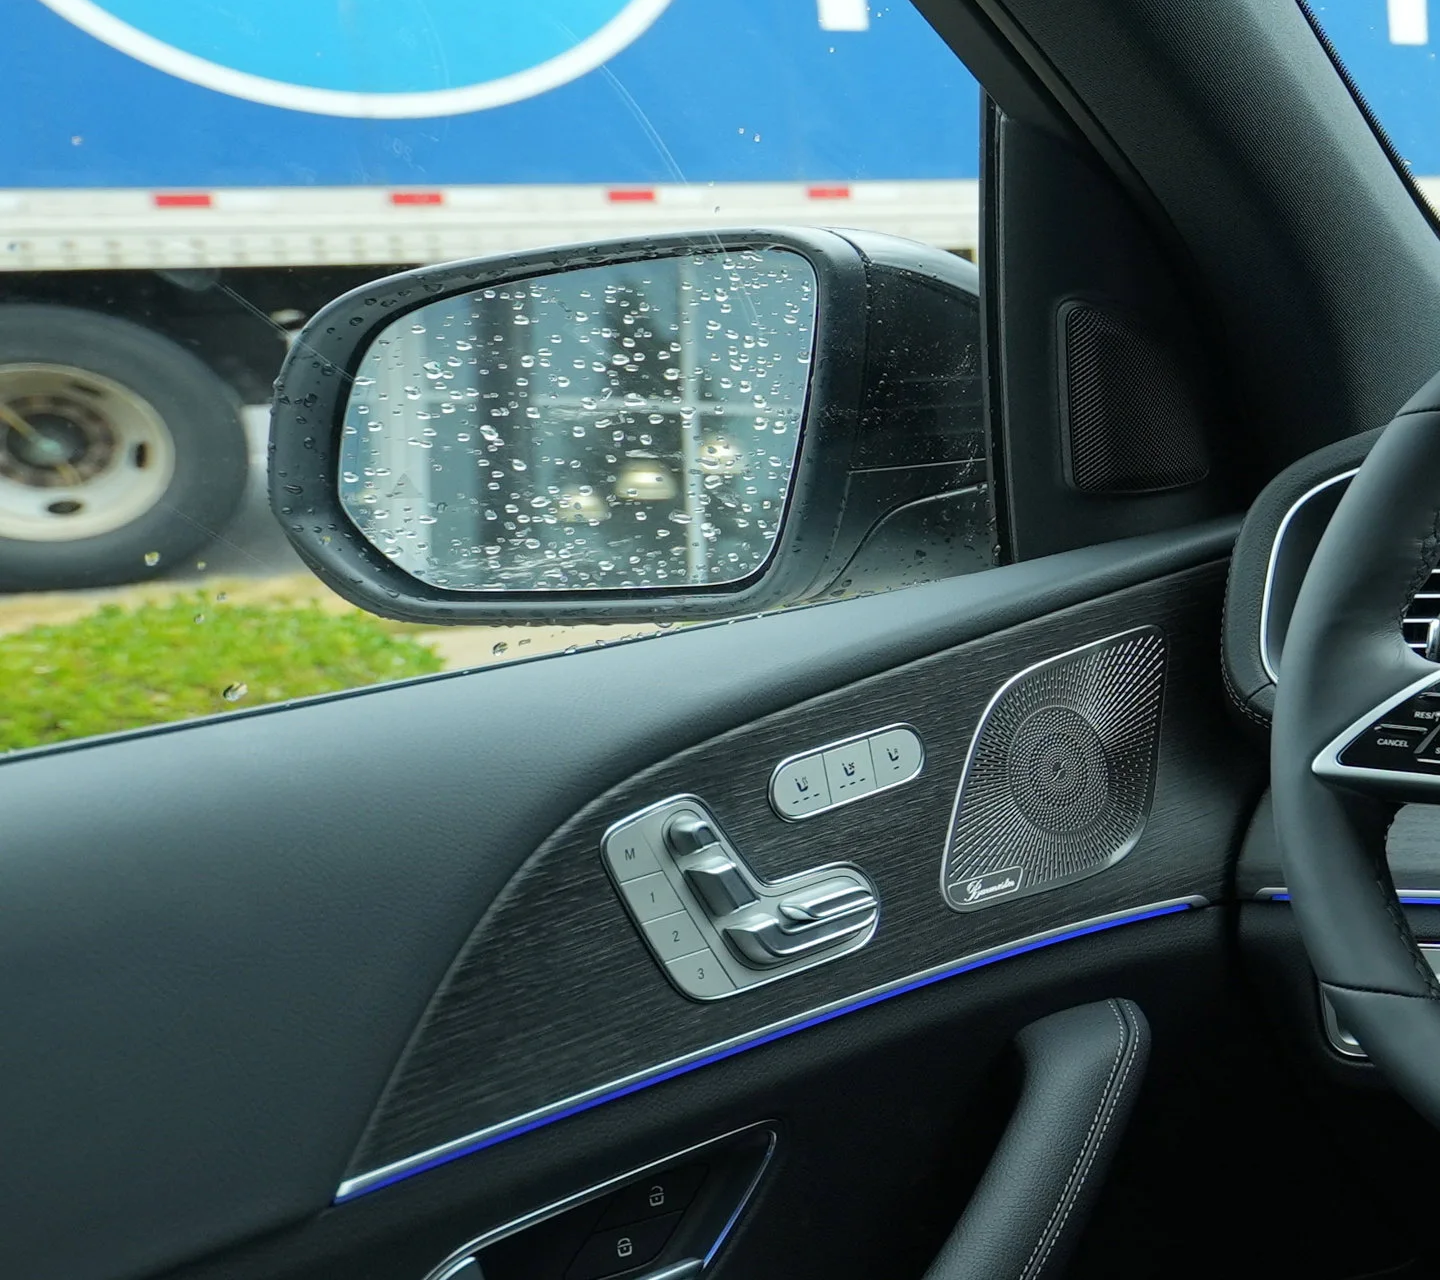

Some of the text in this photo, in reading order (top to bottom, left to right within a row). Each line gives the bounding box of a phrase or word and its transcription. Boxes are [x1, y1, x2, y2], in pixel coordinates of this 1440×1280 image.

[1377, 738, 1410, 747] CANCEL
[624, 848, 636, 861] M
[650, 893, 655, 903] 1
[672, 930, 680, 942] 2
[698, 968, 705, 979] 3
